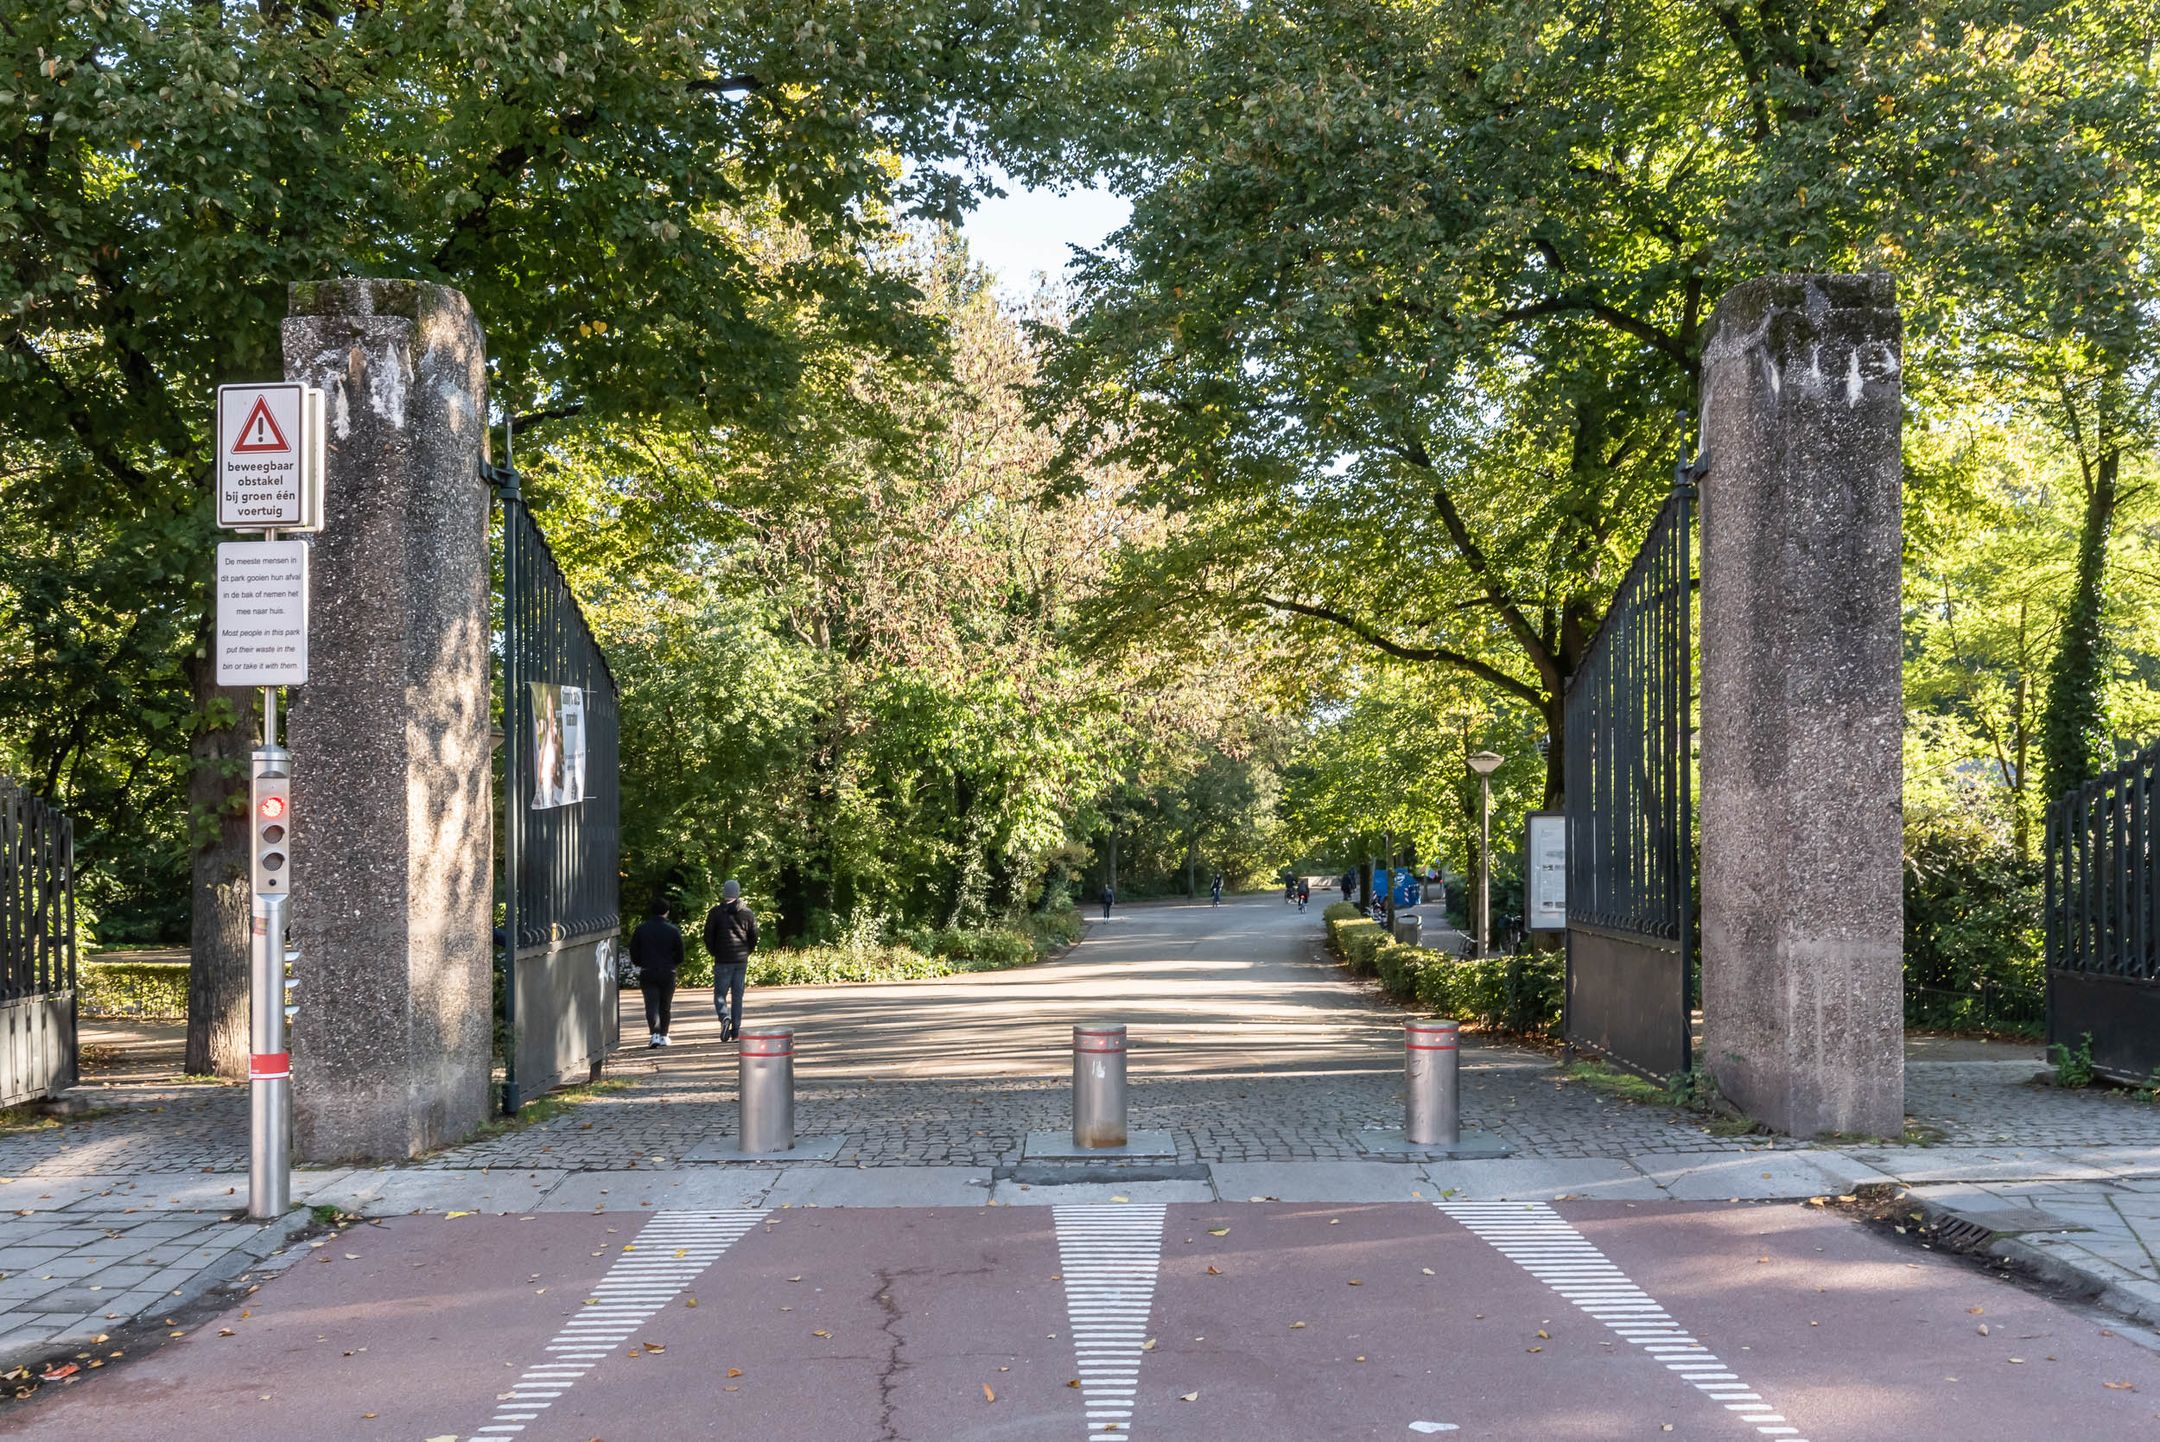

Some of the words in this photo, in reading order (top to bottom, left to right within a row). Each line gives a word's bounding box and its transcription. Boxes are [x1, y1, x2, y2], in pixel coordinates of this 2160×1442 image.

[228, 461, 294, 473] beweegbaar
[238, 475, 283, 486] obstakel
[226, 491, 238, 503] bij
[242, 493, 272, 503] groen
[276, 491, 295, 500] één
[238, 505, 282, 517] voertuig
[240, 629, 262, 637] people
